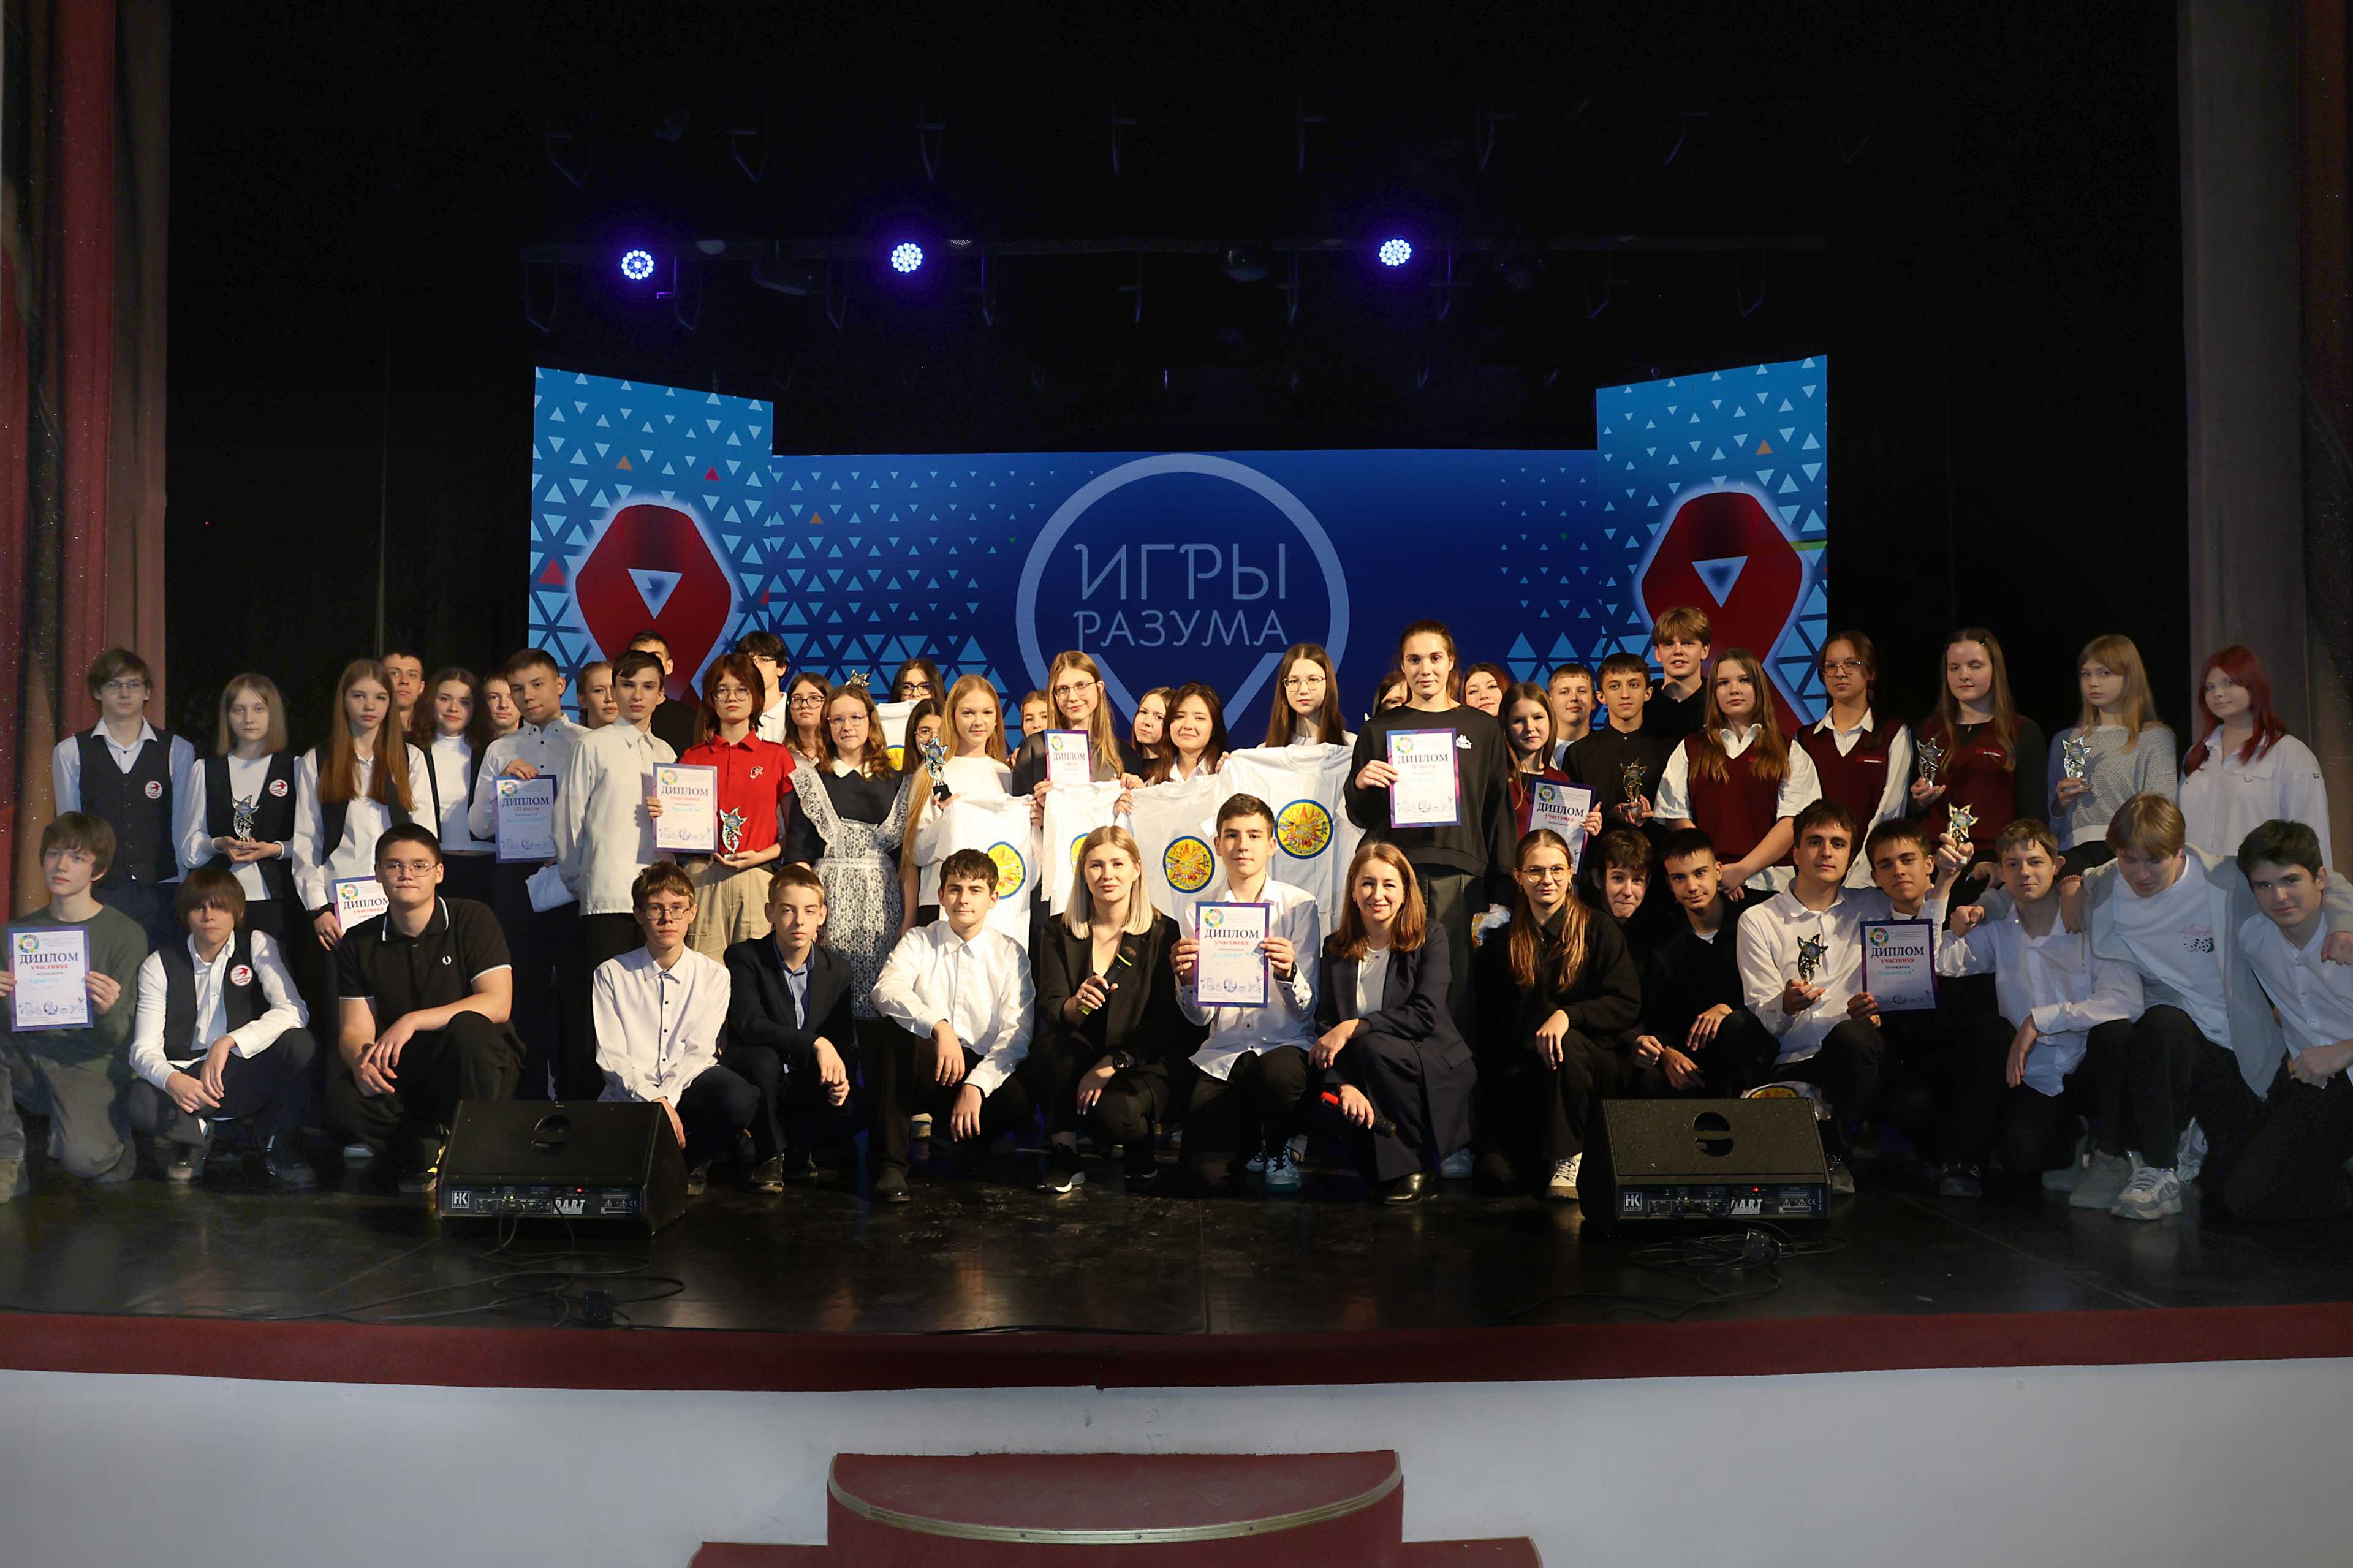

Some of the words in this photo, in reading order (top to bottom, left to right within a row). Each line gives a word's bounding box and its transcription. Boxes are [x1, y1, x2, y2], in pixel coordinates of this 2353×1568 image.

[1074, 543, 1286, 600] ИГРЫ
[1074, 609, 1288, 651] РАЗУМА
[1053, 752, 1086, 762] ДИПЛОМ
[1398, 753, 1449, 765] ДИПЛОМ
[661, 786, 709, 796] ДИПЛОМ
[502, 797, 550, 808] ДИПЛОМ
[1537, 802, 1585, 817] ДИПЛОМ
[1544, 813, 1574, 822] участника
[1204, 928, 1259, 939] ДИПЛОМ
[1871, 946, 1925, 958] ДИПЛОМ
[20, 952, 79, 966] ДИПЛОМ
[453, 1192, 468, 1205] HK
[1626, 1194, 1640, 1206] HK
